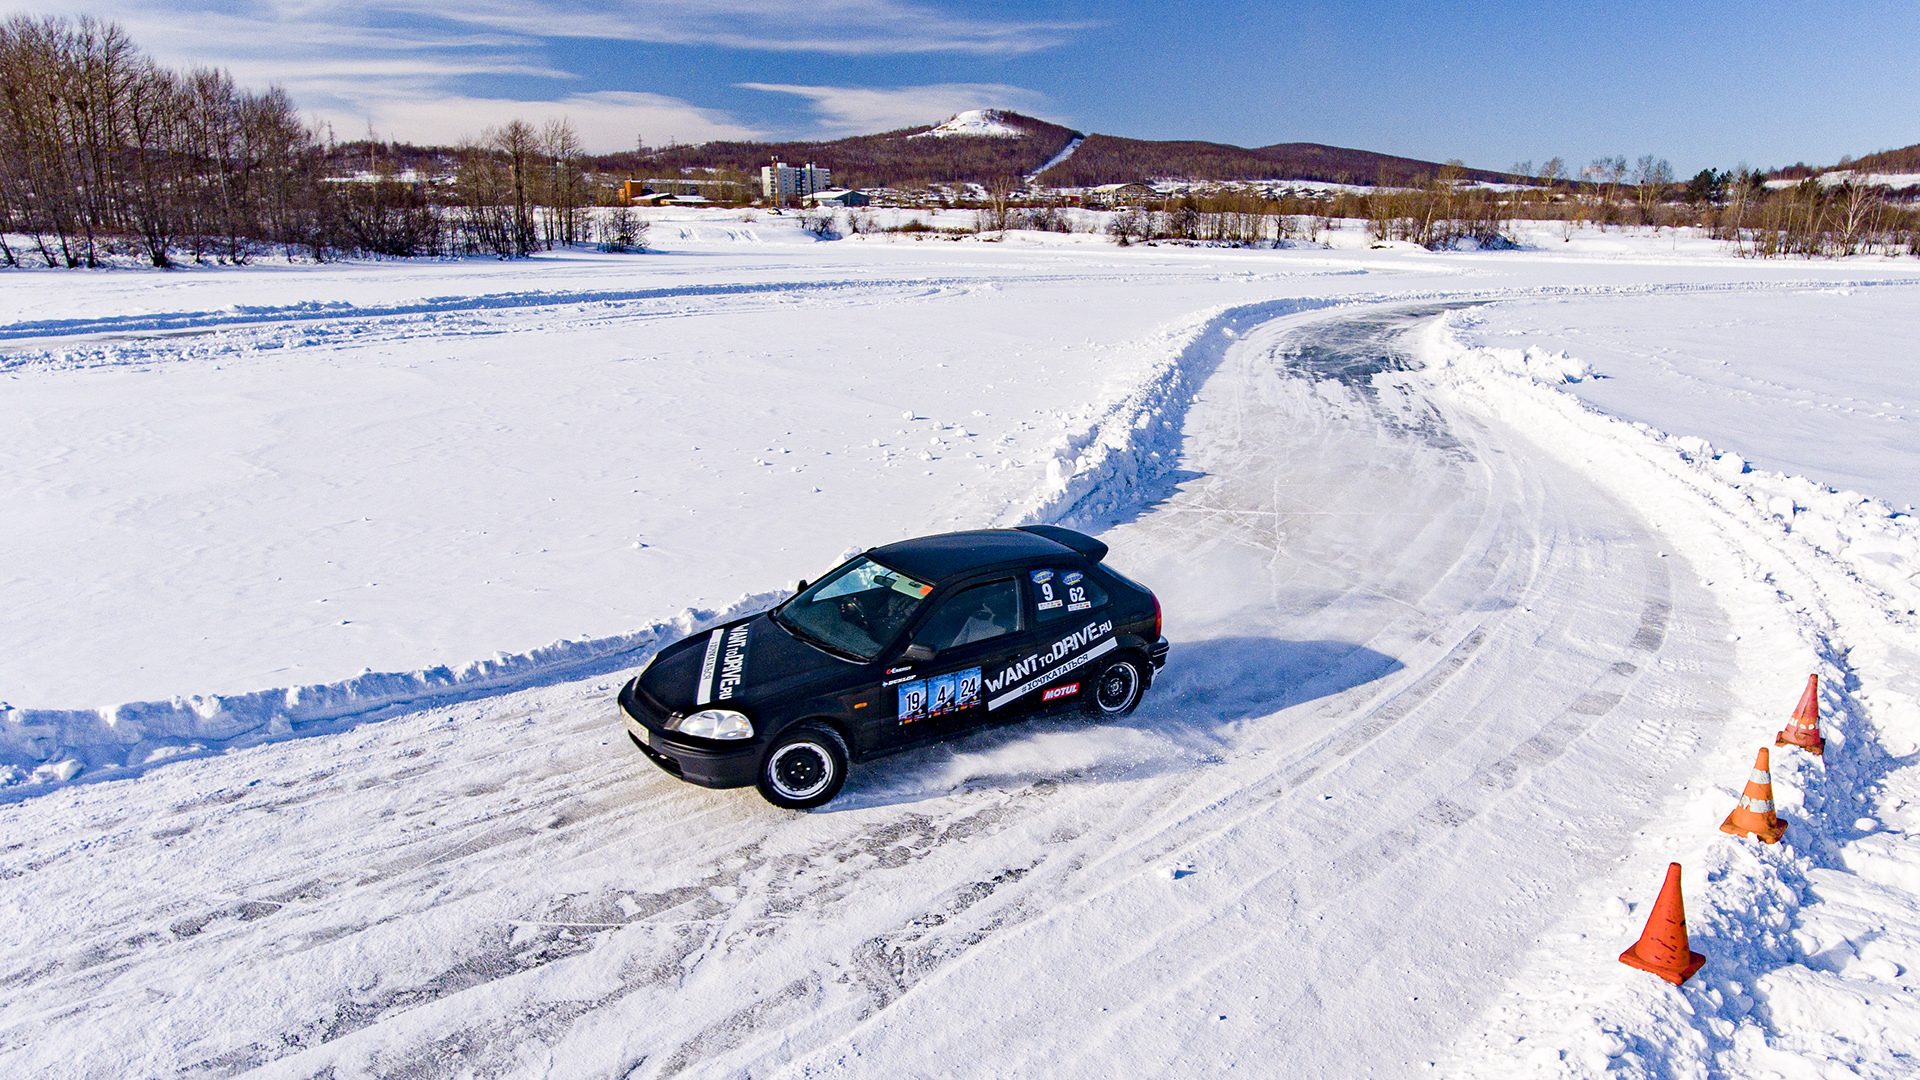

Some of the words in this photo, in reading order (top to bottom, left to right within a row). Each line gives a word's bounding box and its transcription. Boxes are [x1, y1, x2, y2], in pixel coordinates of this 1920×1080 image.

[1042, 582, 1054, 601] 9
[1069, 586, 1086, 603] 62
[937, 684, 946, 704] 4
[960, 676, 977, 698] 24
[1043, 684, 1079, 700] MOTUL
[905, 691, 921, 712] 19
